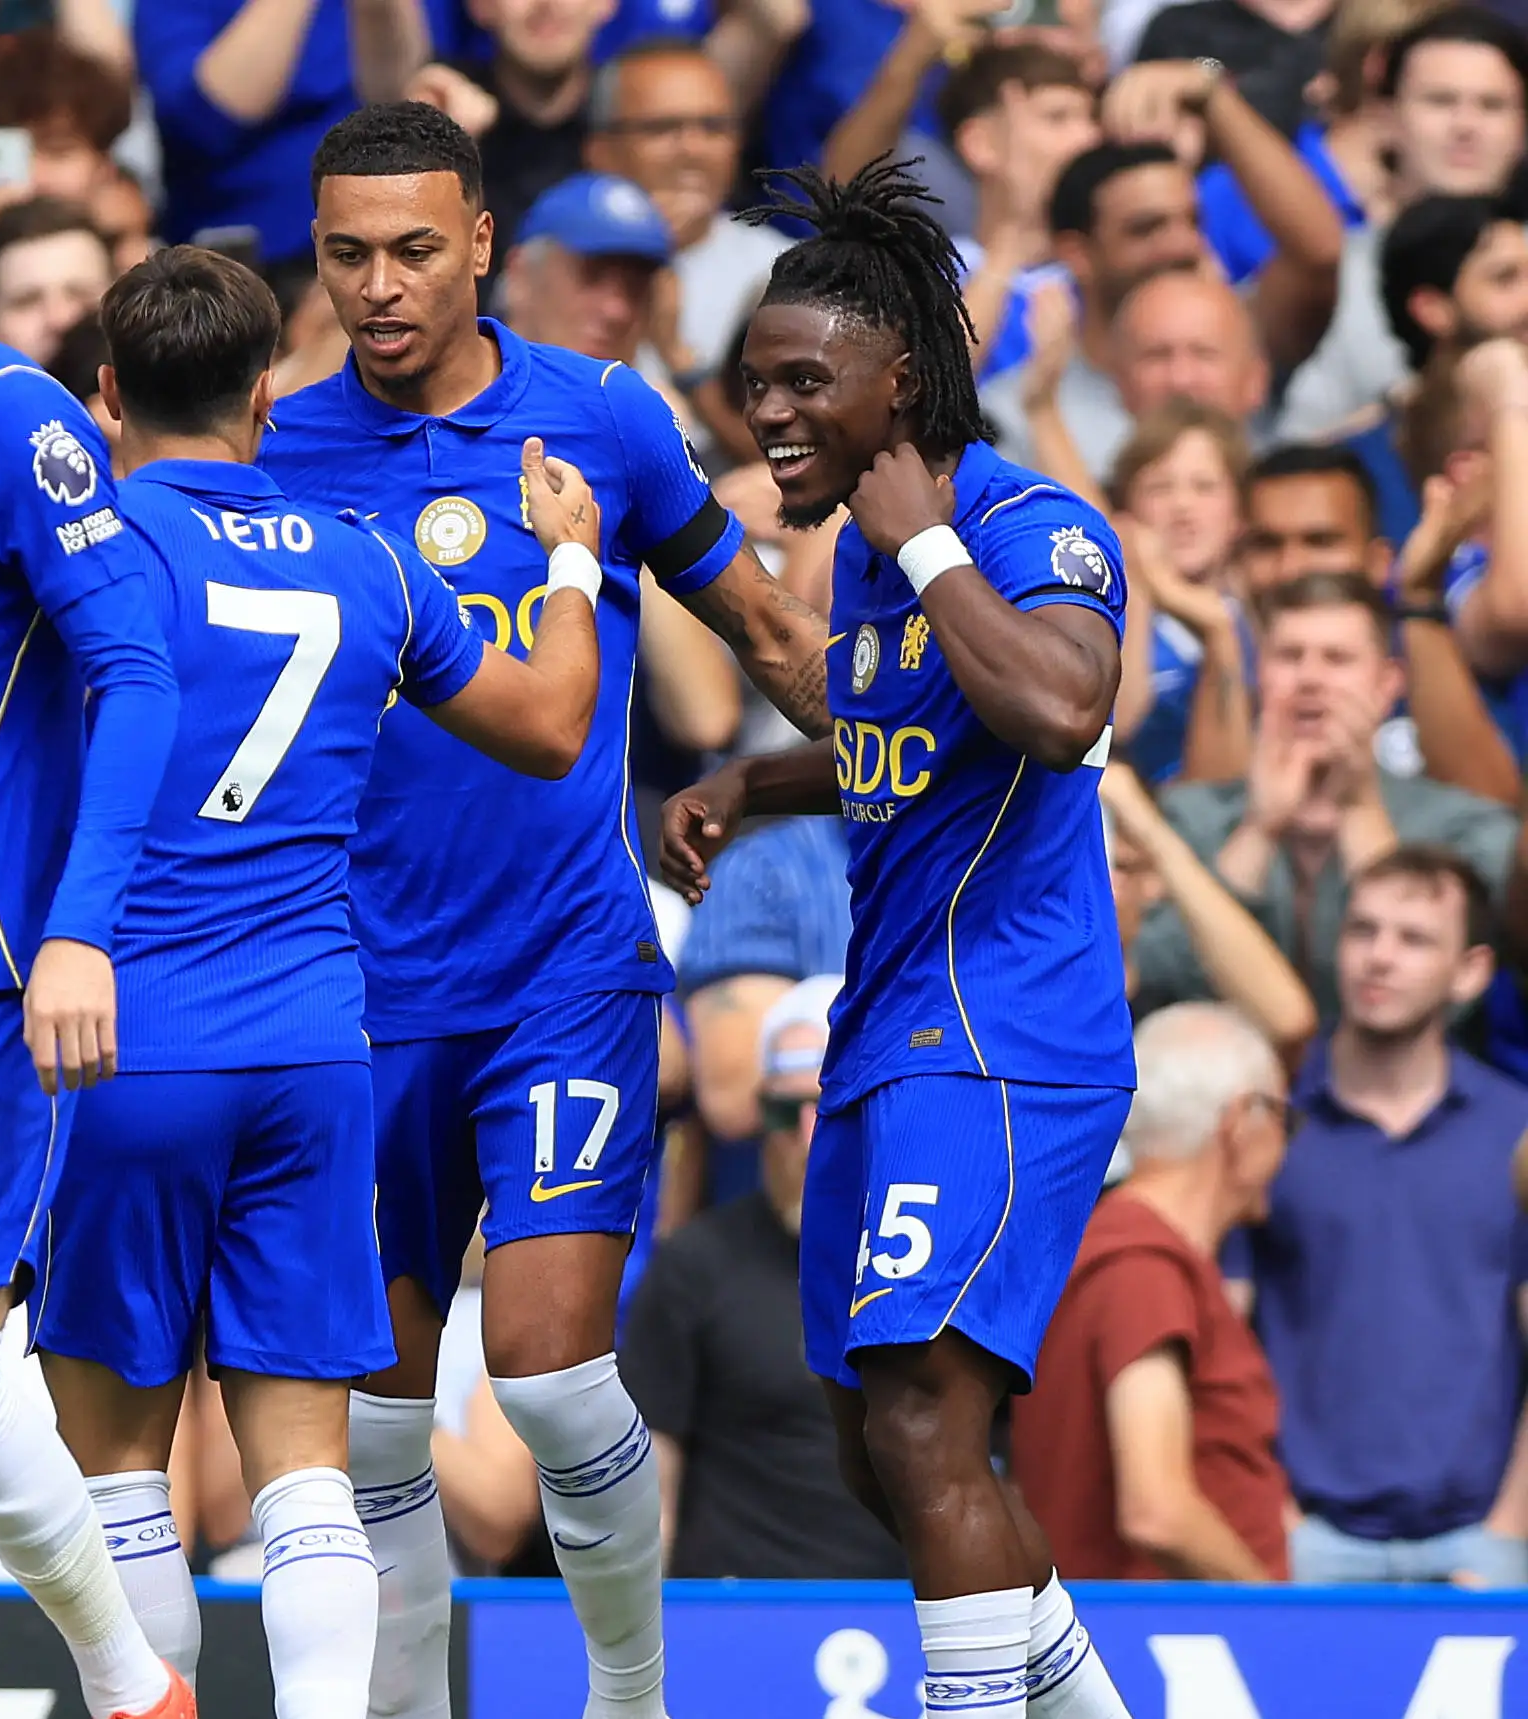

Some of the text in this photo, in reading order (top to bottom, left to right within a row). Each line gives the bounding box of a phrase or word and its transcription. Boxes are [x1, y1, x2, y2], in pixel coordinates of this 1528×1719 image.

[82, 508, 115, 532] room
[62, 533, 87, 556] for
[438, 548, 465, 561] FIFA
[198, 580, 341, 823] 7
[834, 718, 936, 796] SDC
[528, 1079, 619, 1172] 17
[298, 1533, 360, 1547] CFC
